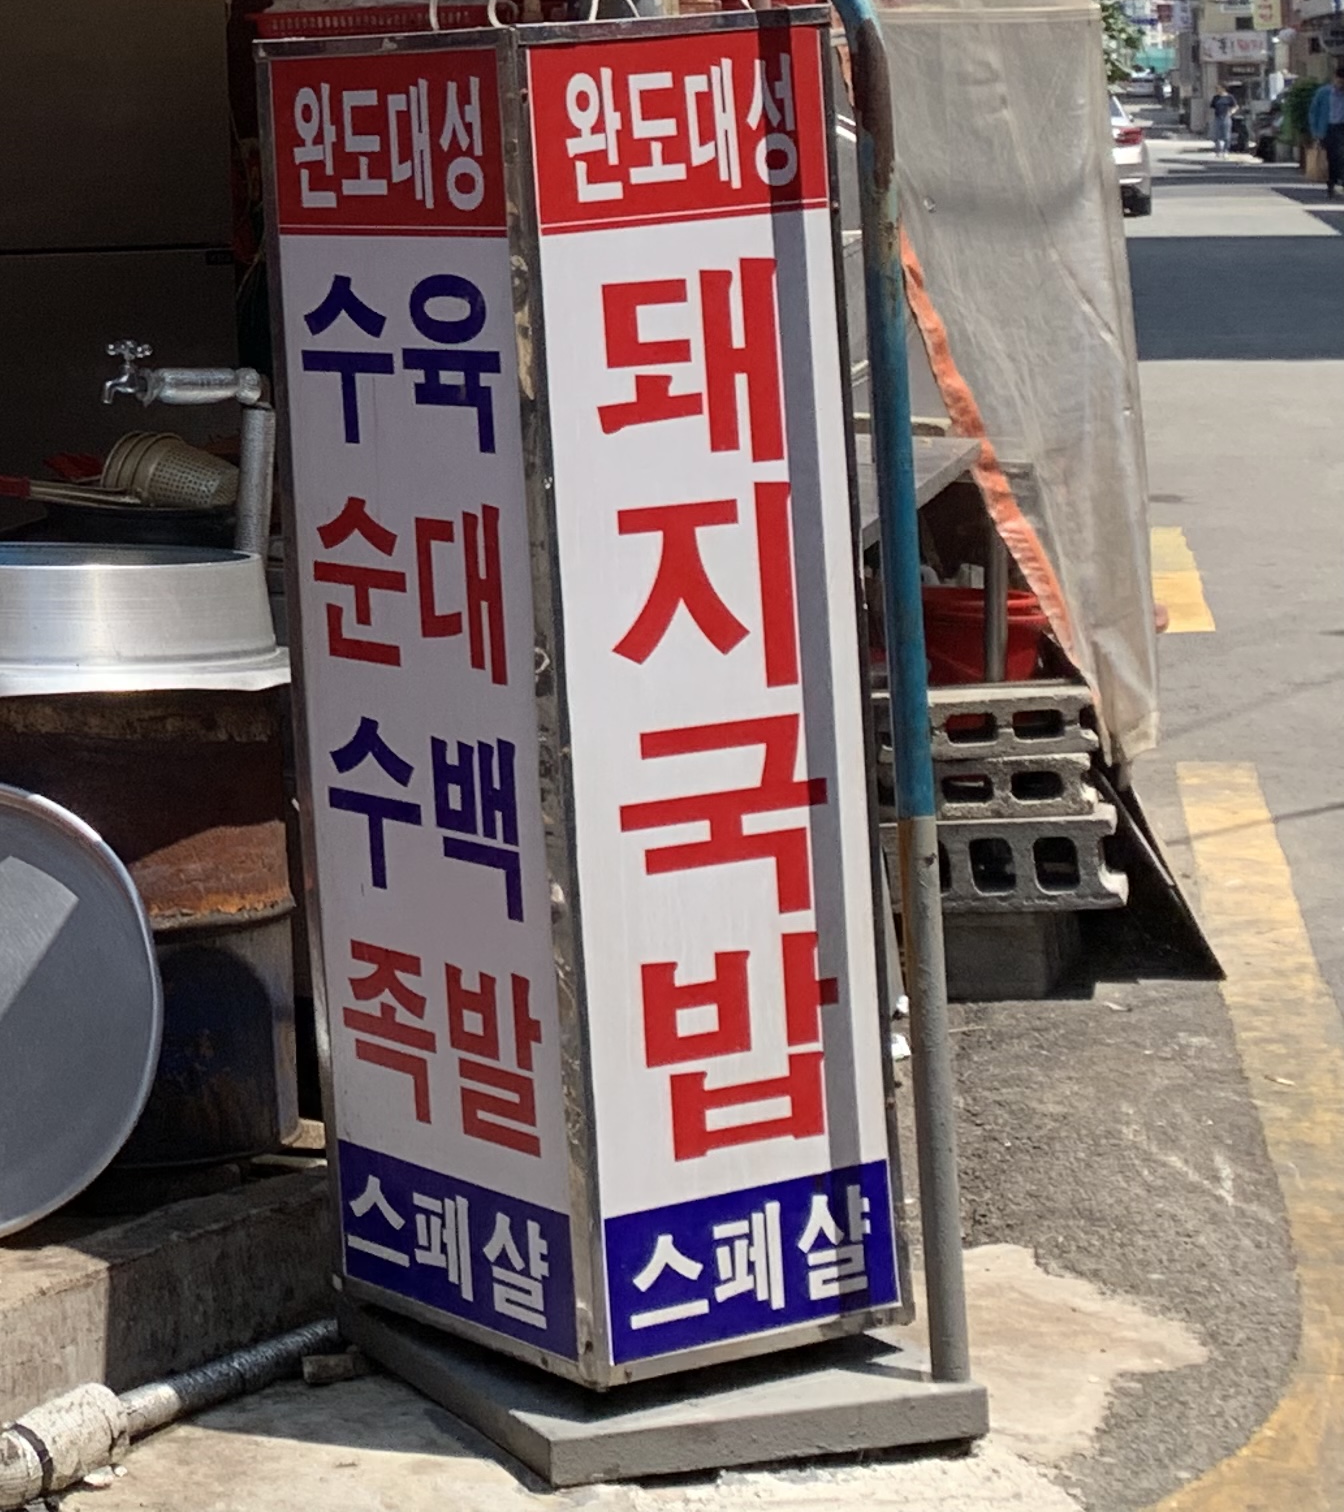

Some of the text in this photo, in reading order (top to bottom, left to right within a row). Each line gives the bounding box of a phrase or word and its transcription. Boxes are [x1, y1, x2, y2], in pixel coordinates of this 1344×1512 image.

[293, 74, 485, 213] 완도대성
[564, 52, 799, 204] 완도대성
[301, 273, 502, 455] 수육
[313, 496, 508, 686] 순대
[597, 257, 839, 1162] 돼지국밥
[327, 716, 524, 923] 수백
[343, 938, 542, 1158] 족발
[347, 1175, 550, 1330] 스페샬
[630, 1184, 872, 1330] 스페샬
